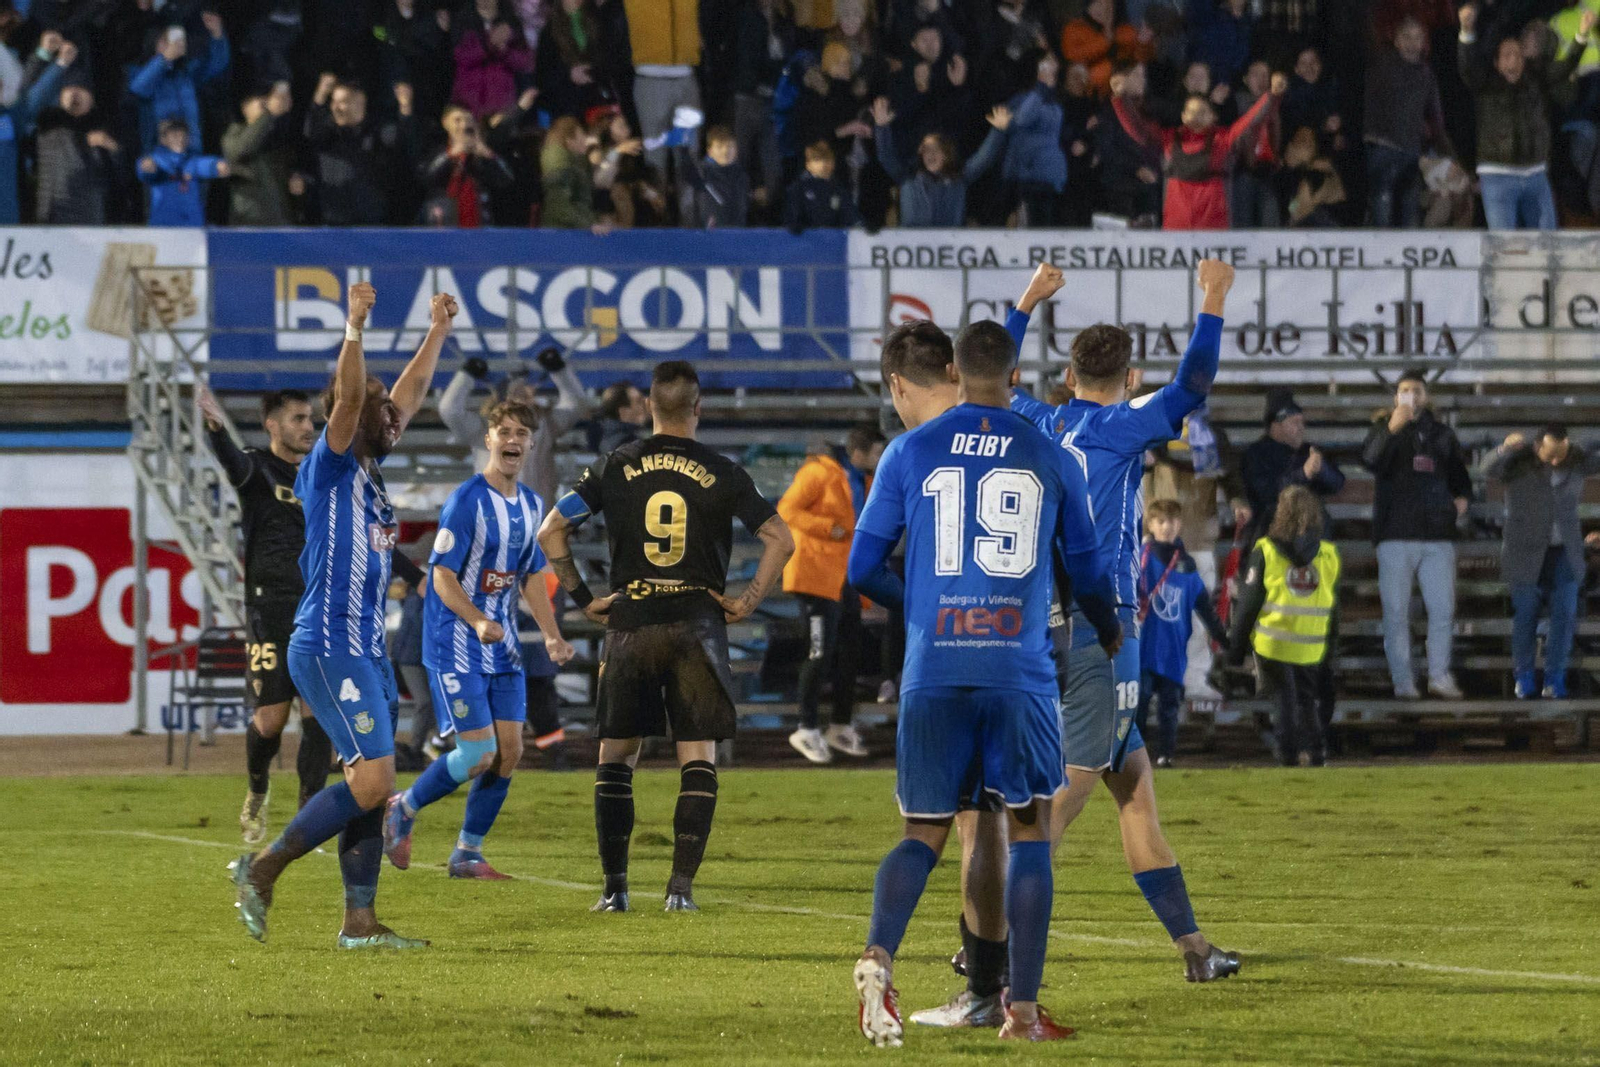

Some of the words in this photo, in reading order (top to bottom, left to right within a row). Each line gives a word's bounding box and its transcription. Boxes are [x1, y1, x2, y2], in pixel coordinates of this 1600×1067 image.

[871, 245, 999, 269] BODEGA
[1028, 245, 1247, 269] RESTAURANTE
[1276, 246, 1363, 269] HOTEL
[1402, 246, 1457, 269] SPA
[1236, 300, 1301, 356] de
[950, 433, 1013, 457] DEIBY
[623, 463, 642, 481] A.
[641, 453, 716, 488] NEGREDO
[644, 490, 687, 567] 9
[922, 467, 1044, 579] 19
[939, 594, 978, 606] Bodegas
[979, 596, 987, 606] y
[988, 594, 1023, 606] Viñedos
[936, 606, 1022, 636] neo
[251, 642, 277, 671] 25
[934, 638, 1022, 648] www.bodegasneo.com
[339, 677, 361, 702] 4
[442, 673, 461, 694] 5
